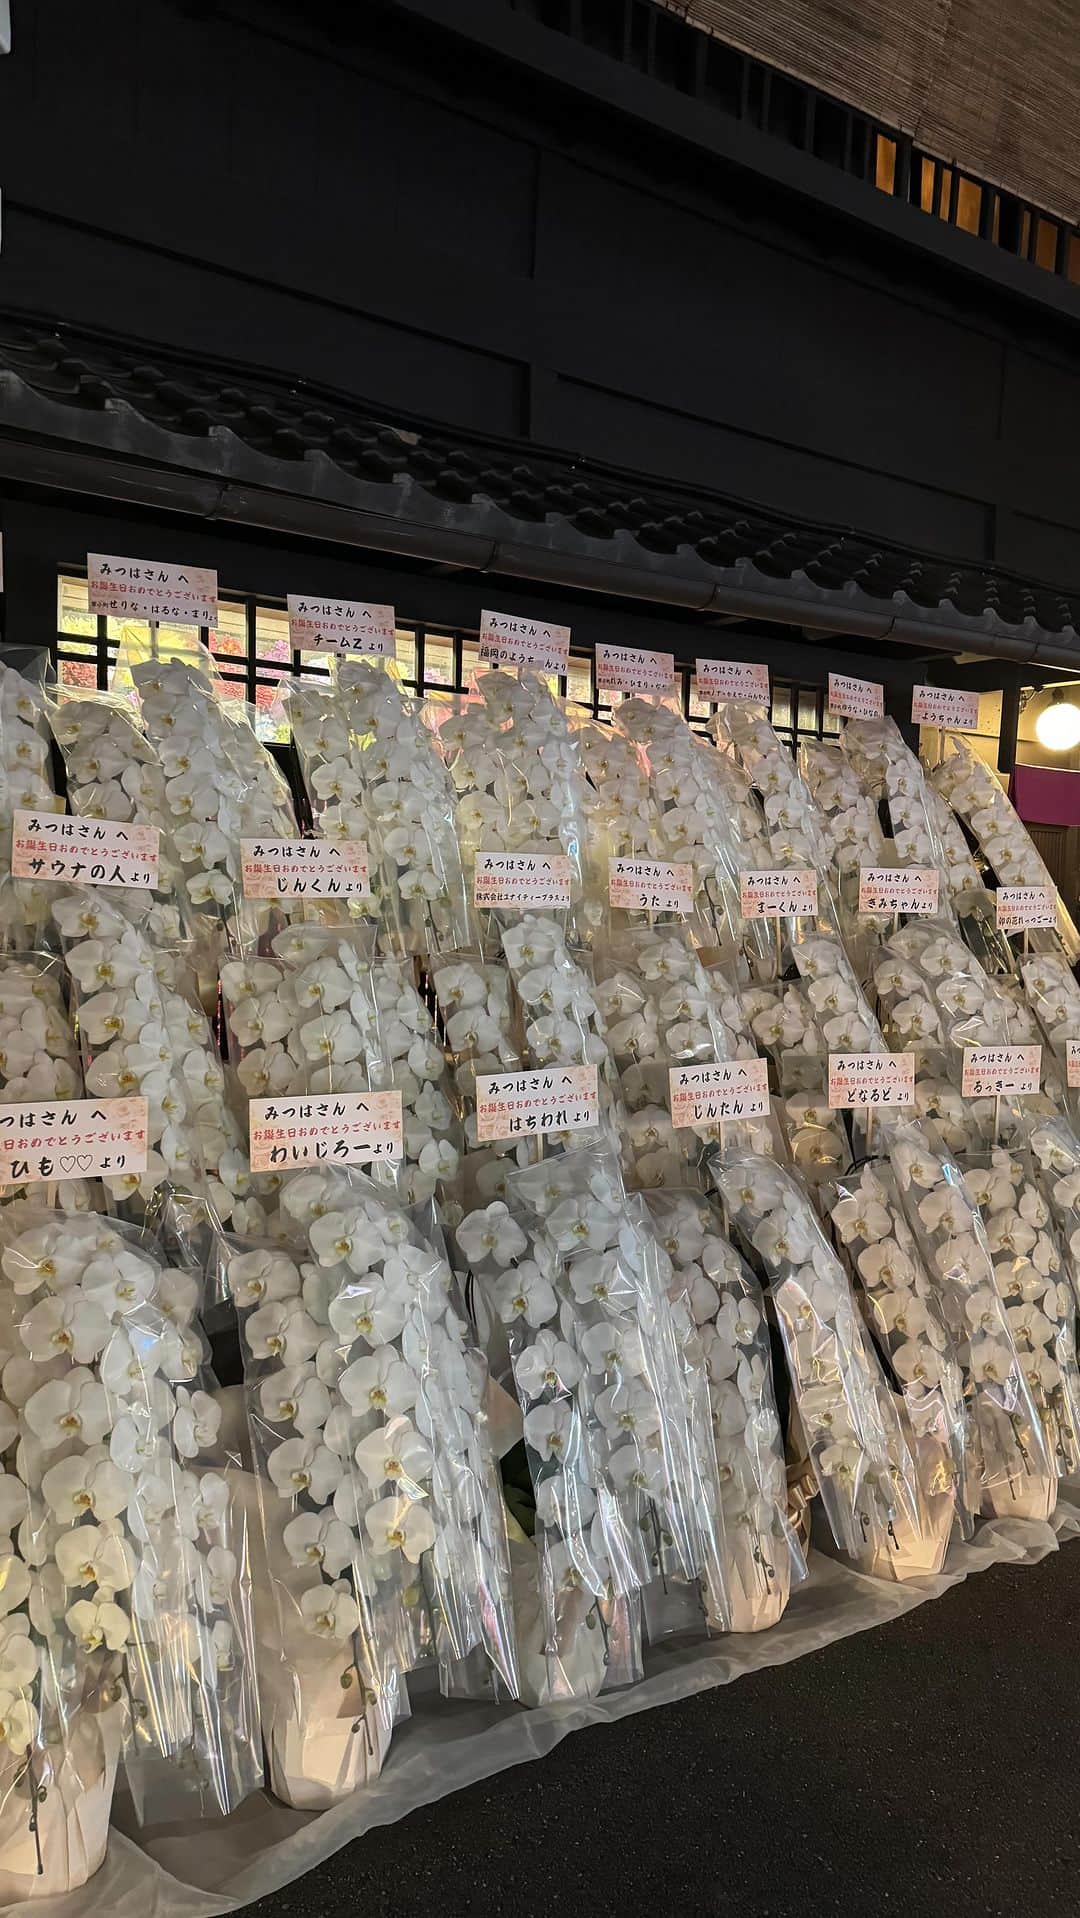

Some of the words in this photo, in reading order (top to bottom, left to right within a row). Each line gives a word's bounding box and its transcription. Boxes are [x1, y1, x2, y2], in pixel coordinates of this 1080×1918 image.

[29, 858, 150, 883] サウナの人より
[277, 877, 362, 892] じんくんより
[757, 900, 813, 913] まーくんより
[868, 898, 933, 910] きみちゃんより
[847, 1086, 909, 1103] どなるどより
[694, 1099, 763, 1120] じんたんより
[509, 1110, 590, 1132] はちわれより
[0, 1130, 145, 1151] 日おめでとうございます
[270, 1139, 394, 1163] わいじろーより
